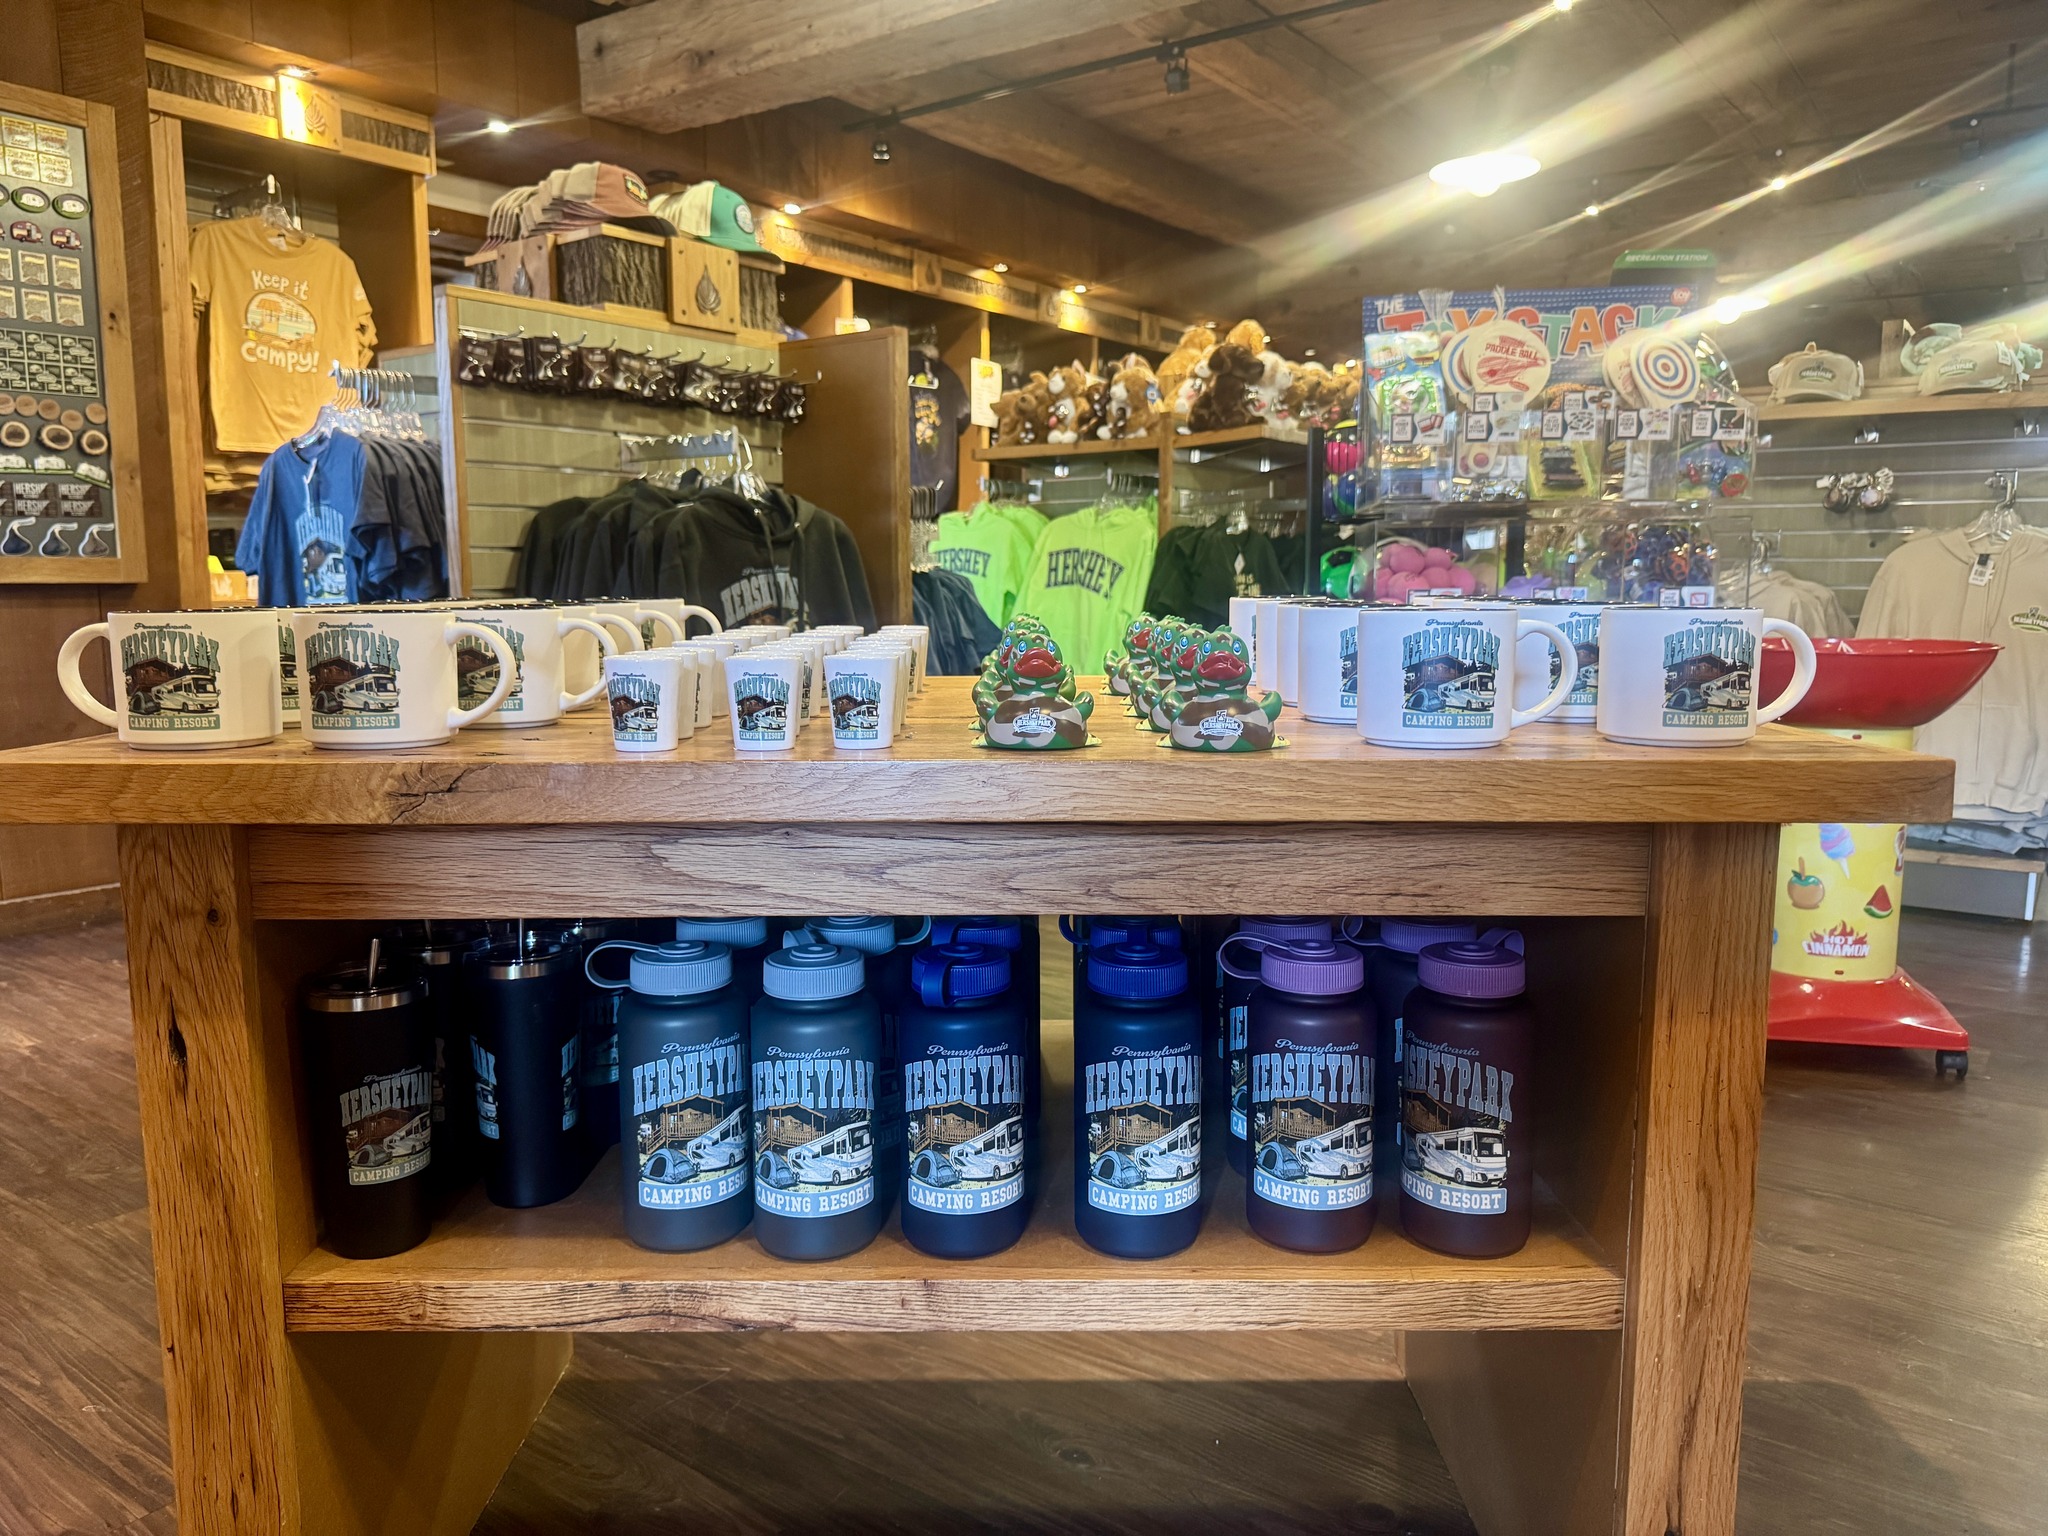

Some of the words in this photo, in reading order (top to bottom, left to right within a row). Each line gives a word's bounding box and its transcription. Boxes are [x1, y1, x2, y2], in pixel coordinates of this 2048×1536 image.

[251, 269, 290, 293] Keep
[293, 280, 310, 301] it
[1375, 296, 1405, 314] THE
[241, 339, 319, 373] Campy!
[1485, 342, 1517, 357] PADDLE
[1519, 349, 1538, 361] BALL
[1045, 547, 1125, 600] HERSHEY
[1426, 618, 1483, 628] Pennsylvania
[1569, 611, 1601, 620] Pennsyl
[1689, 618, 1743, 627] Pennsylvania
[134, 622, 192, 630] Pennsylvania
[318, 621, 373, 630] Pennsylvania
[120, 630, 221, 673] HERSHEYPARK
[305, 629, 400, 672] HERSHEYPARK
[1402, 627, 1500, 670] HERSHEYPARK
[733, 677, 790, 704] HERSHEYPARK
[829, 677, 881, 704] HERSHEYPARK
[1567, 694, 1593, 703] PING
[461, 700, 482, 710] PING
[130, 717, 169, 728] CAMPING
[174, 716, 217, 728] RESORT
[313, 716, 351, 728] CAMPING
[356, 716, 397, 728] RESORT
[1405, 714, 1453, 727] CAMPING
[1457, 715, 1492, 727] RESORT
[1666, 714, 1713, 726] CAMPING
[1718, 714, 1748, 726] RESORT
[634, 733, 656, 741] RESORT
[741, 732, 761, 740] CAMPING
[764, 731, 785, 739] RESORT
[835, 731, 854, 739] CAMPING
[857, 731, 877, 739] RESORT
[1802, 941, 1871, 957] CINNAMON
[1823, 935, 1855, 945] HOT
[661, 1032, 740, 1053] Pennsylvania
[927, 1041, 1008, 1059] Pennsylvania
[1112, 1042, 1191, 1059] Pennsylvania
[1275, 1038, 1359, 1056] Pennsylvania
[1405, 1029, 1479, 1056] Pennsylvania
[767, 1046, 850, 1060] Pennsylvania
[632, 1043, 747, 1117] HERSHEYPA
[1085, 1055, 1201, 1114] HERSHEYPAR
[1404, 1044, 1513, 1122] SHEYPARK
[340, 1072, 432, 1128] HERSHEYPAR
[353, 1166, 400, 1182] CAMPING
[404, 1152, 431, 1174] RESO
[643, 1183, 711, 1204] CAMPING
[718, 1166, 747, 1197] RESO
[1257, 1177, 1319, 1205] CAMPING
[1327, 1176, 1372, 1205] RESORT
[1402, 1176, 1433, 1202] MPING
[1440, 1188, 1501, 1210] RESORT
[756, 1185, 811, 1213] CAMPING
[819, 1182, 871, 1212] RESORT
[911, 1185, 973, 1210] CAMPING
[1092, 1185, 1154, 1210] CAMPING
